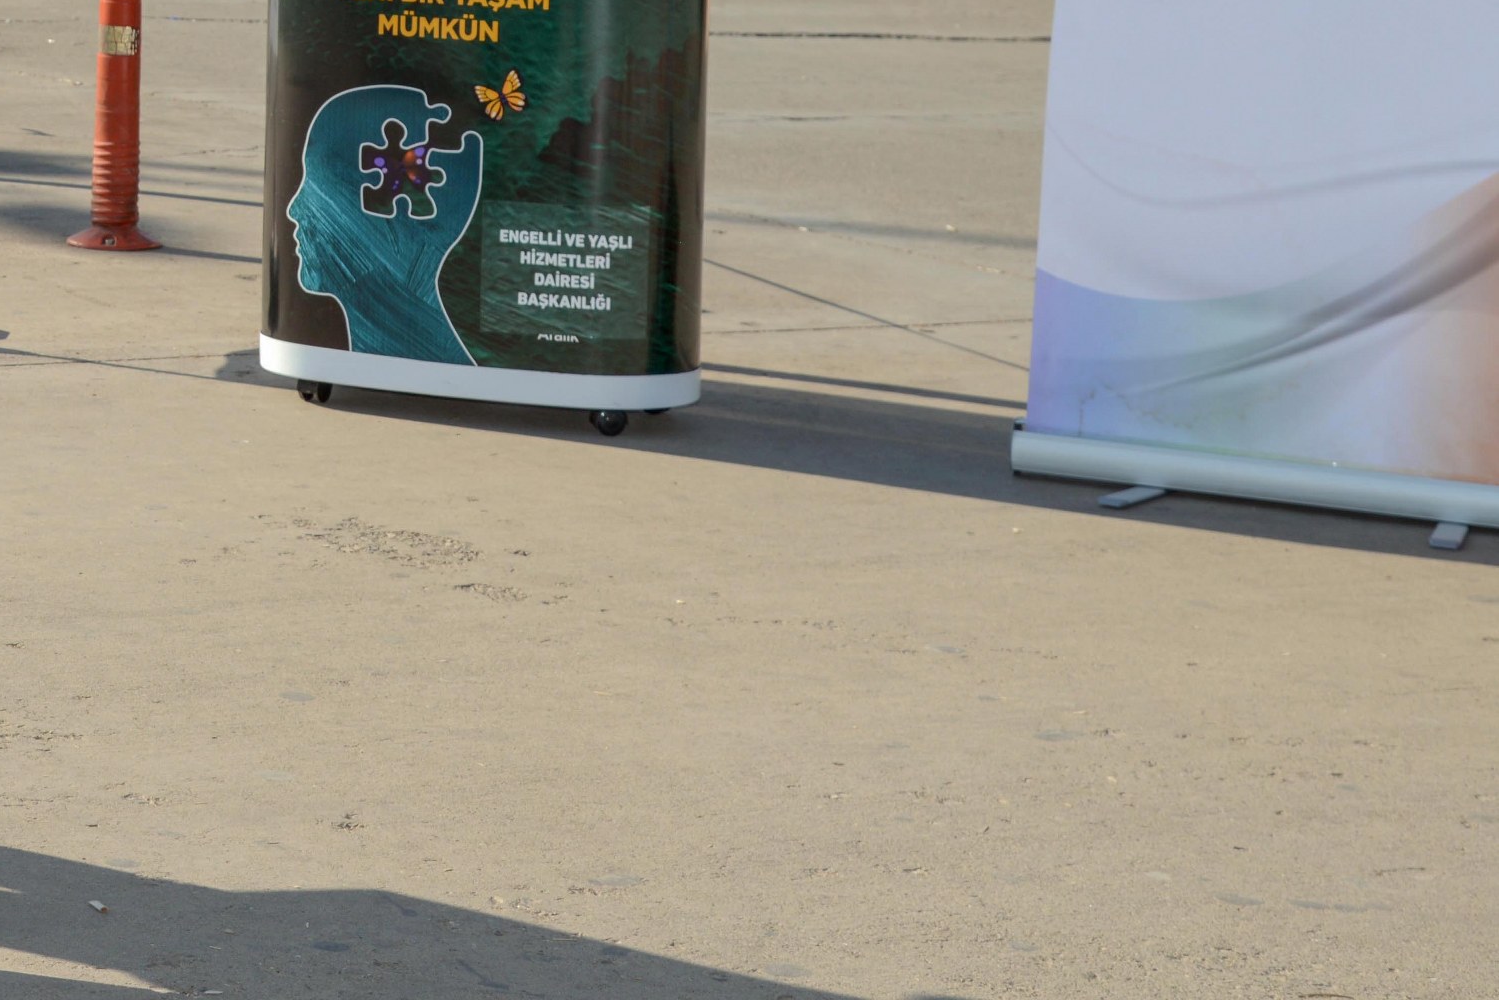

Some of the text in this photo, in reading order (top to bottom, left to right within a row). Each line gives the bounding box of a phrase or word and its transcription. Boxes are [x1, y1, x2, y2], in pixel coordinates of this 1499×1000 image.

[378, 10, 499, 42] MÜMKÜN
[499, 229, 633, 251] ENGELLİ VE YAŞLI
[520, 248, 610, 269] HİZMETLERİ
[534, 271, 595, 289] DAİRESİ
[517, 291, 611, 311] BAŞKANLIĞI
